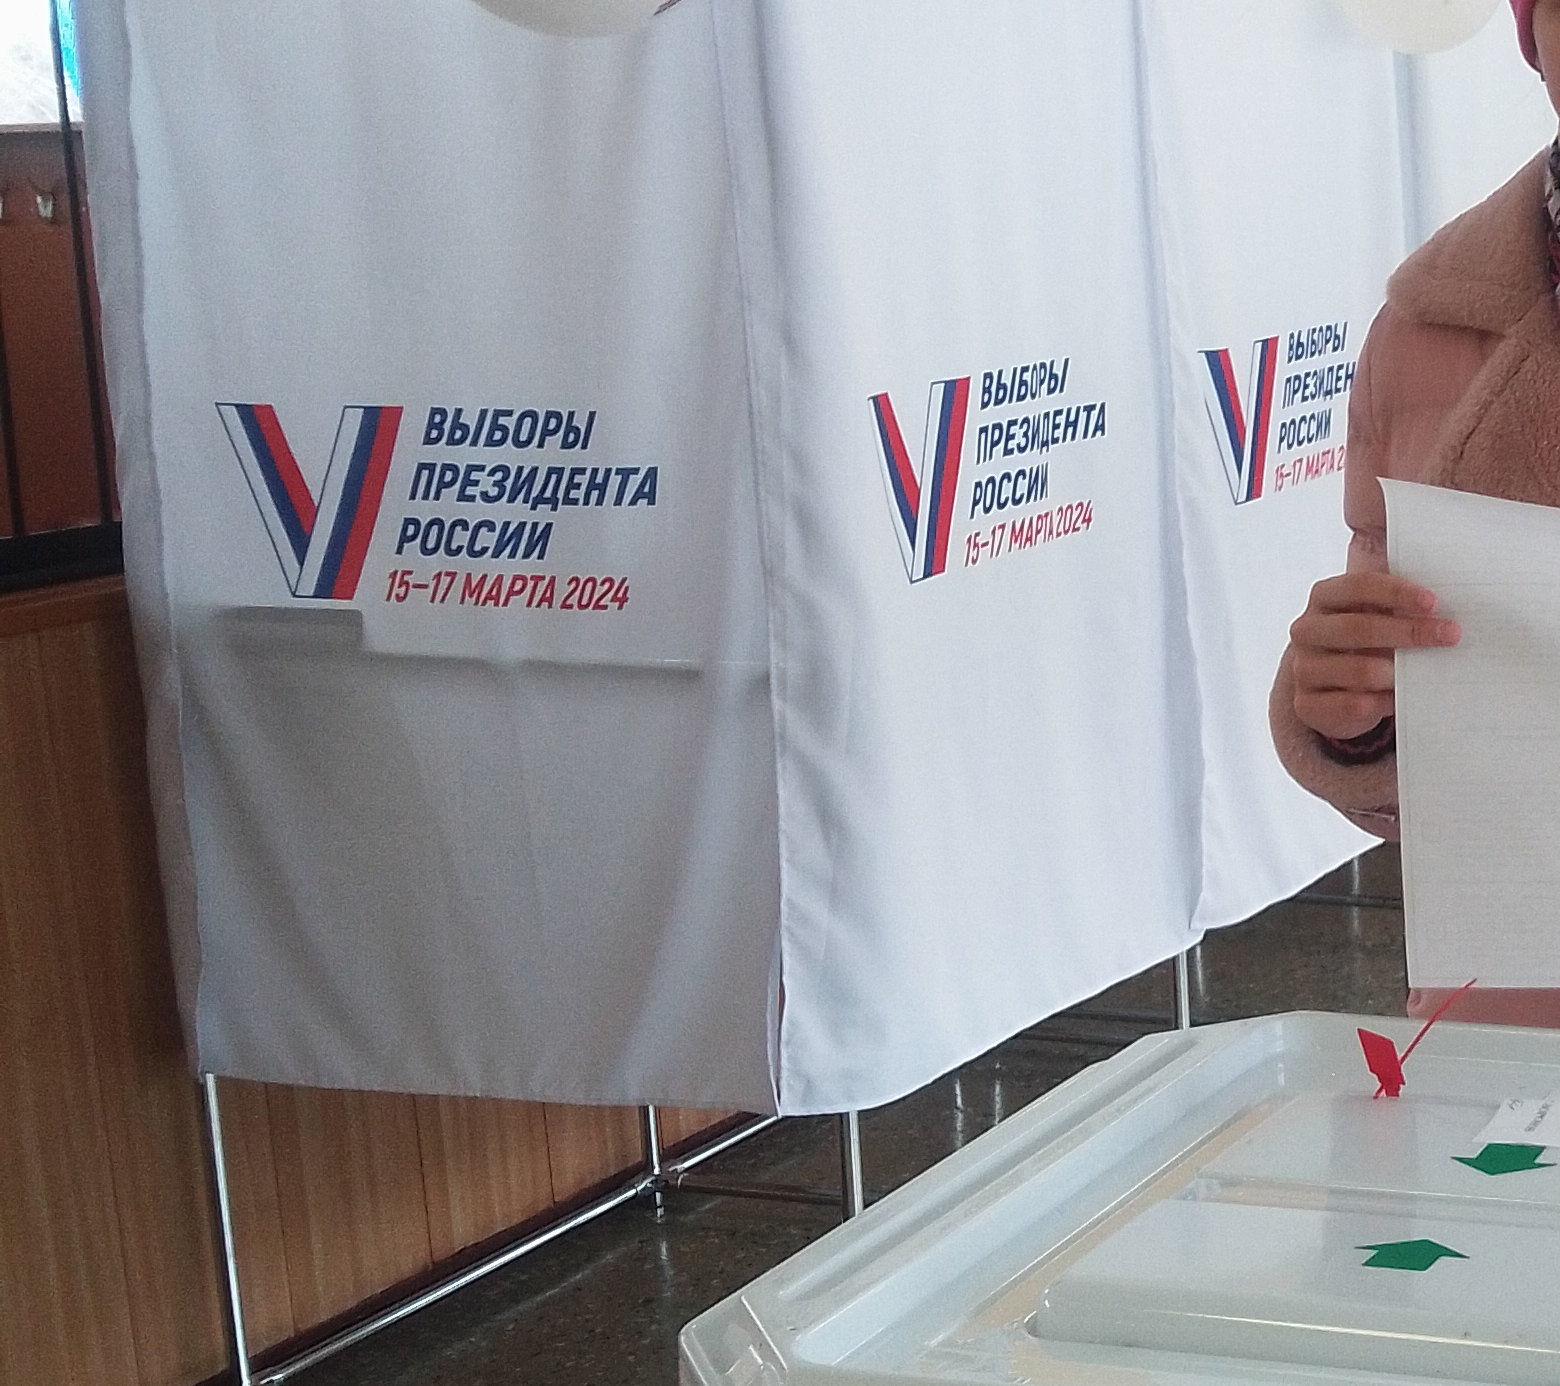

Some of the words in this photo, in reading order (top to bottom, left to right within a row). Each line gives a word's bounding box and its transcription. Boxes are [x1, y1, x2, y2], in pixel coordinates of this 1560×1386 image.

[1287, 321, 1348, 364] ВЫБОРЫ
[980, 357, 1070, 410] ВЫБОРЫ
[1282, 361, 1356, 409] ПРЕЗИДЕН
[422, 407, 597, 451] ВЫБОРЫ
[976, 401, 1106, 465] ПРЕЗИДЕНТА
[1277, 408, 1332, 454] РОССИИ
[408, 462, 660, 511] ПРЕЗИДЕНТА
[1304, 447, 1335, 483] МАРТА
[969, 461, 1049, 520] РОССИИ
[395, 517, 555, 561] РОССИИ
[1008, 510, 1054, 553] МАРТА
[1055, 500, 1093, 540] 2024
[460, 572, 555, 610] МАРТА
[559, 575, 630, 612] 2024
